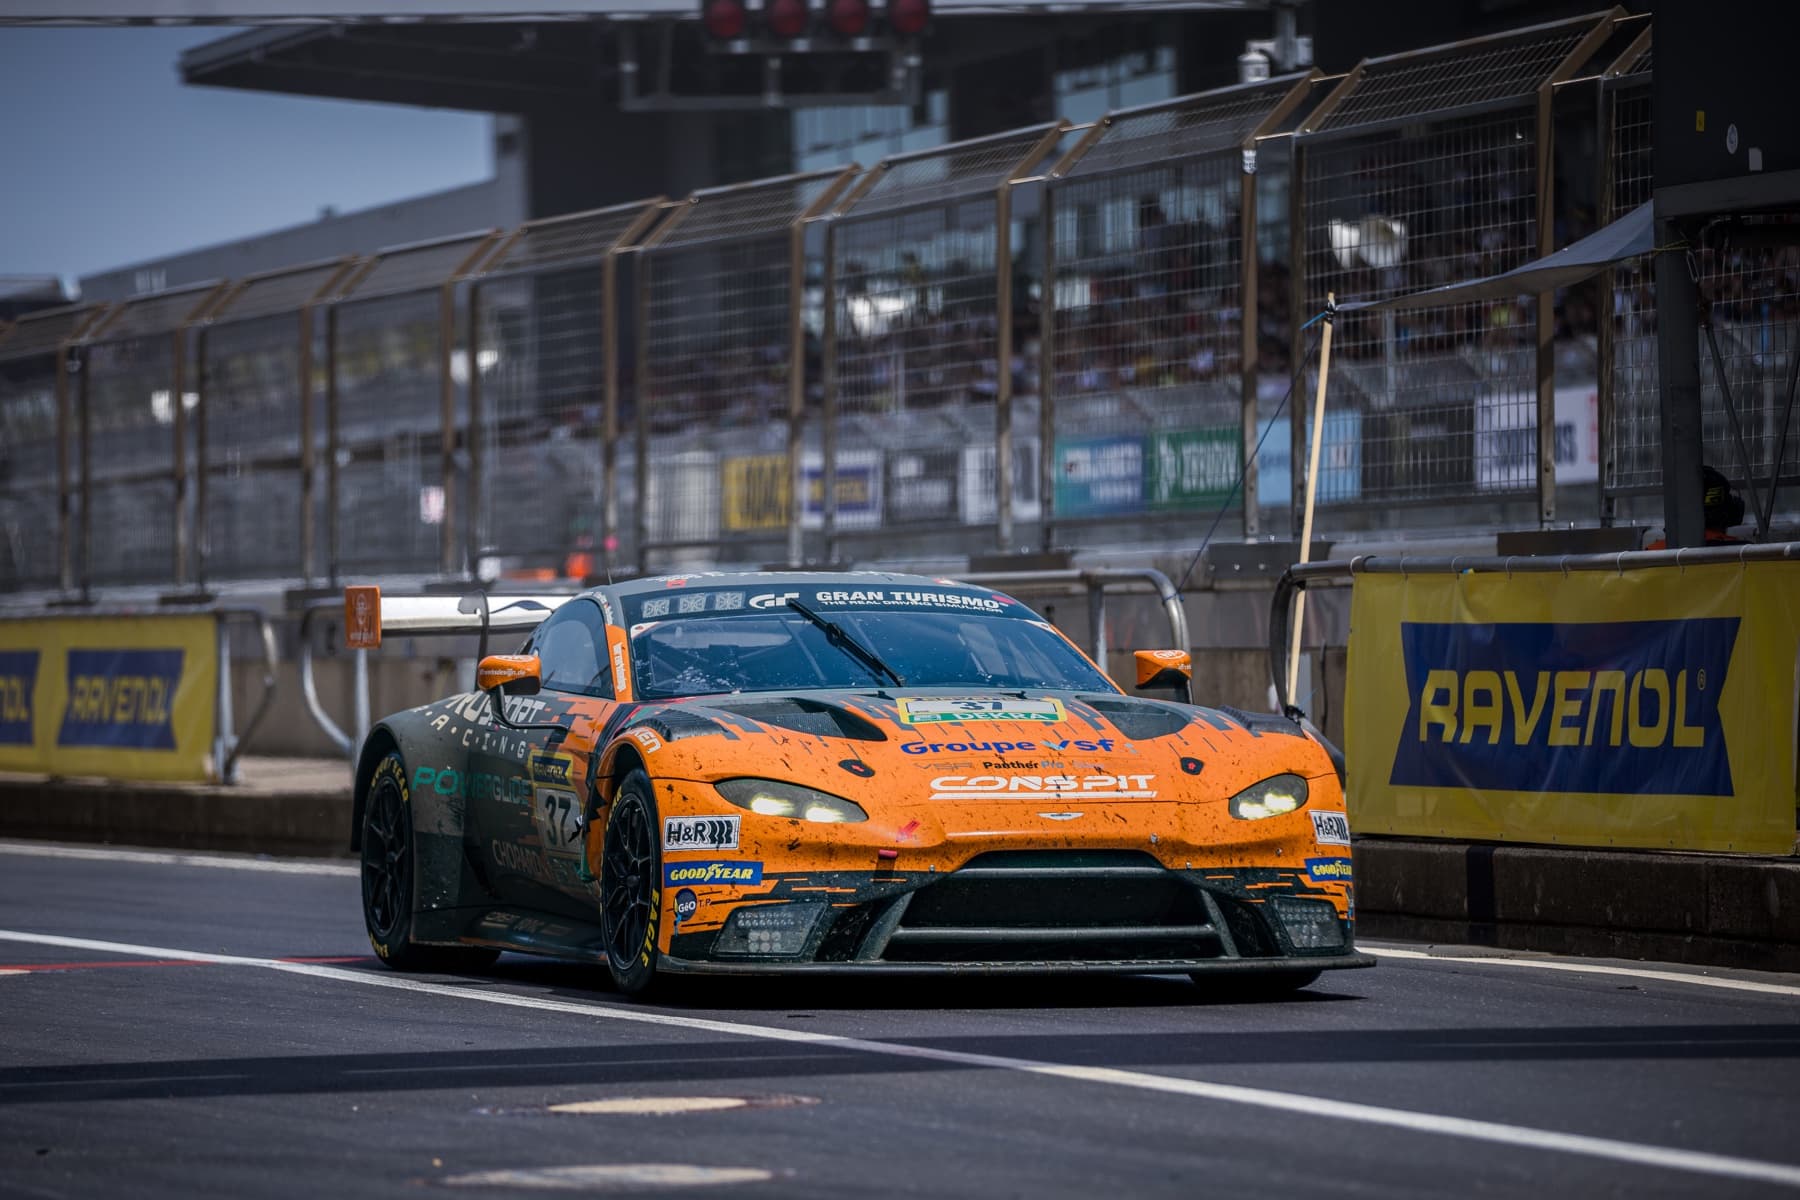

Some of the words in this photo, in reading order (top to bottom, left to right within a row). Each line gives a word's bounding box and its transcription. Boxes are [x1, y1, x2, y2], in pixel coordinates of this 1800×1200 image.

[816, 592, 884, 602] GRAN
[890, 592, 1000, 610] TURISMO
[934, 603, 1004, 613] SIMULATOR
[71, 676, 168, 724] RAVENOL
[1418, 668, 1705, 748] RAVENOL
[900, 740, 1036, 755] Groupe
[983, 761, 1039, 770] Panther
[1041, 761, 1065, 769] Pro
[930, 775, 1156, 791] CONSPIT
[545, 795, 571, 847] 37
[1314, 816, 1338, 838] H&R
[667, 821, 706, 844] H&R
[670, 863, 754, 882] GOODYEAR
[641, 888, 659, 968] EAGLE
